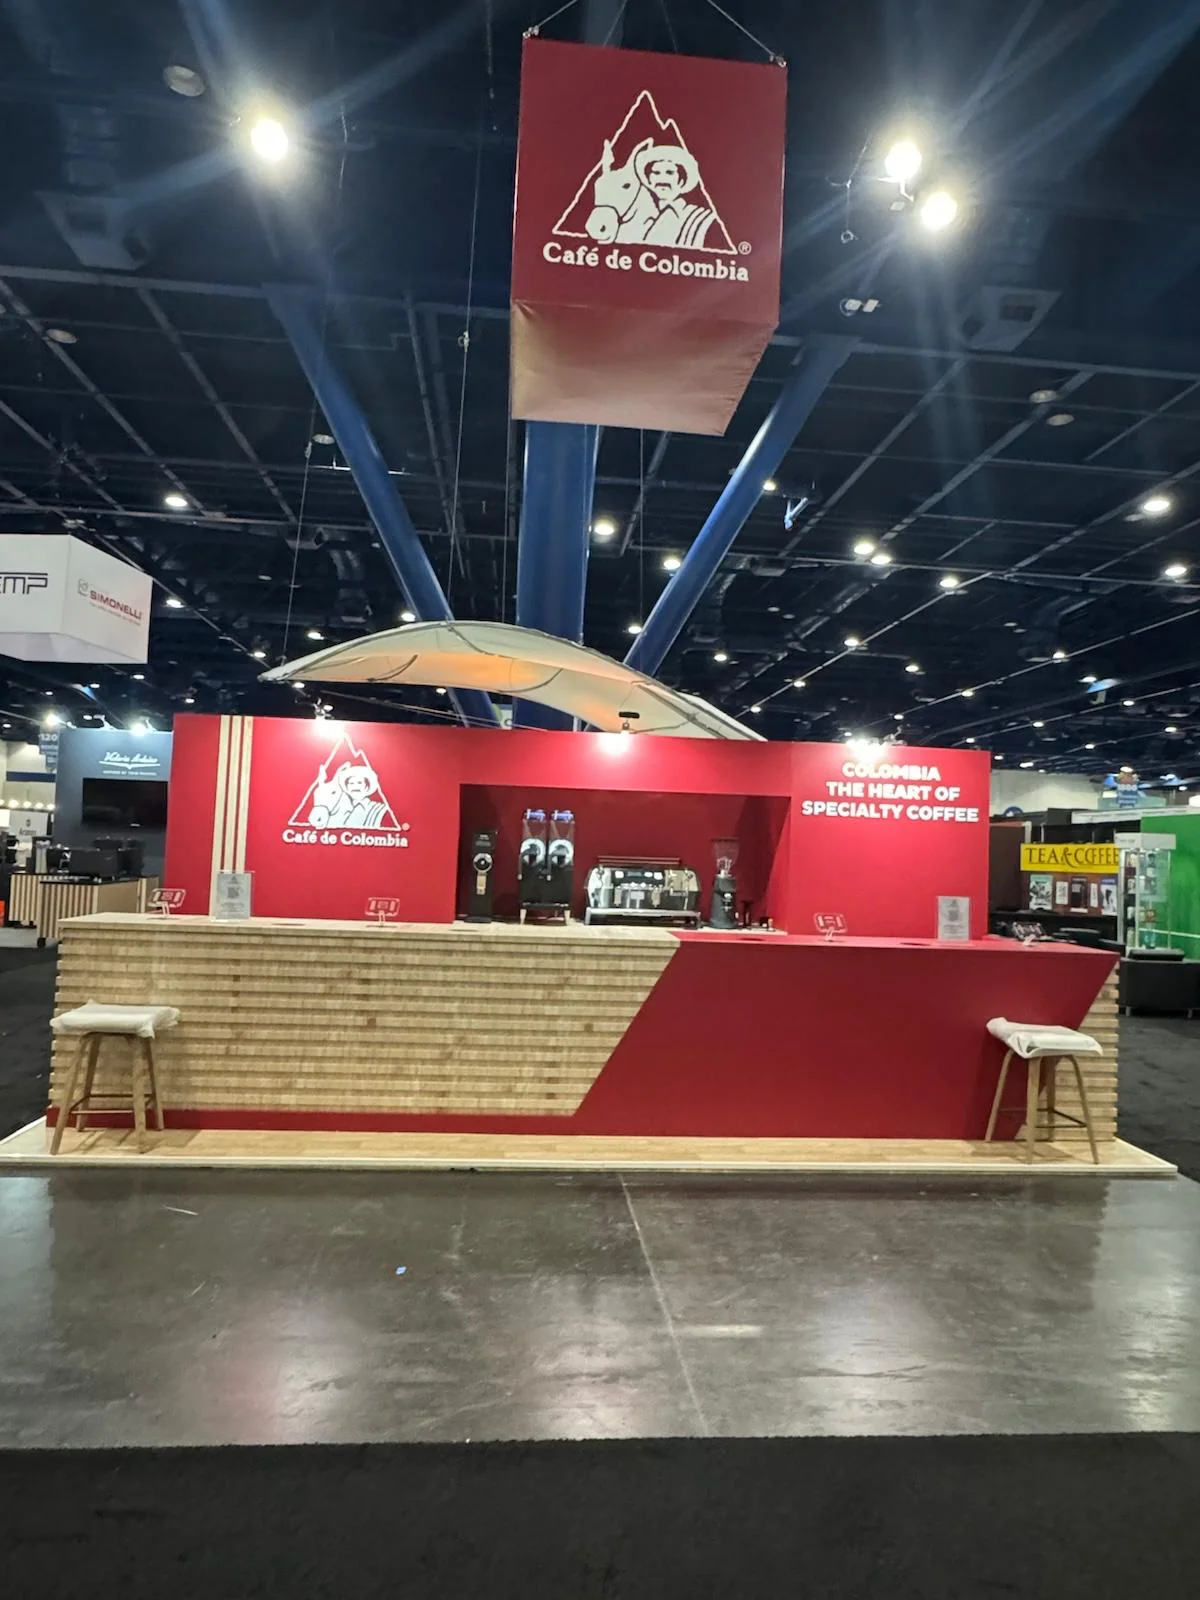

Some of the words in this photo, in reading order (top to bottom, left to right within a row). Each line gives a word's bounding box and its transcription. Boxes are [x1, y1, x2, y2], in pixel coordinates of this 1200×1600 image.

[542, 242, 598, 267] Café
[605, 249, 633, 271] de
[638, 252, 749, 282] Colombia
[89, 589, 143, 620] SIMONELLI
[841, 761, 941, 782] COLOMBIA
[825, 781, 865, 798] THE
[867, 783, 932, 801] HEART
[934, 786, 961, 801] OF
[801, 800, 905, 821] SPECIALTY
[906, 804, 980, 823] COFFEE
[281, 829, 318, 844] Café
[319, 832, 338, 845] de
[339, 832, 409, 848] Colombia
